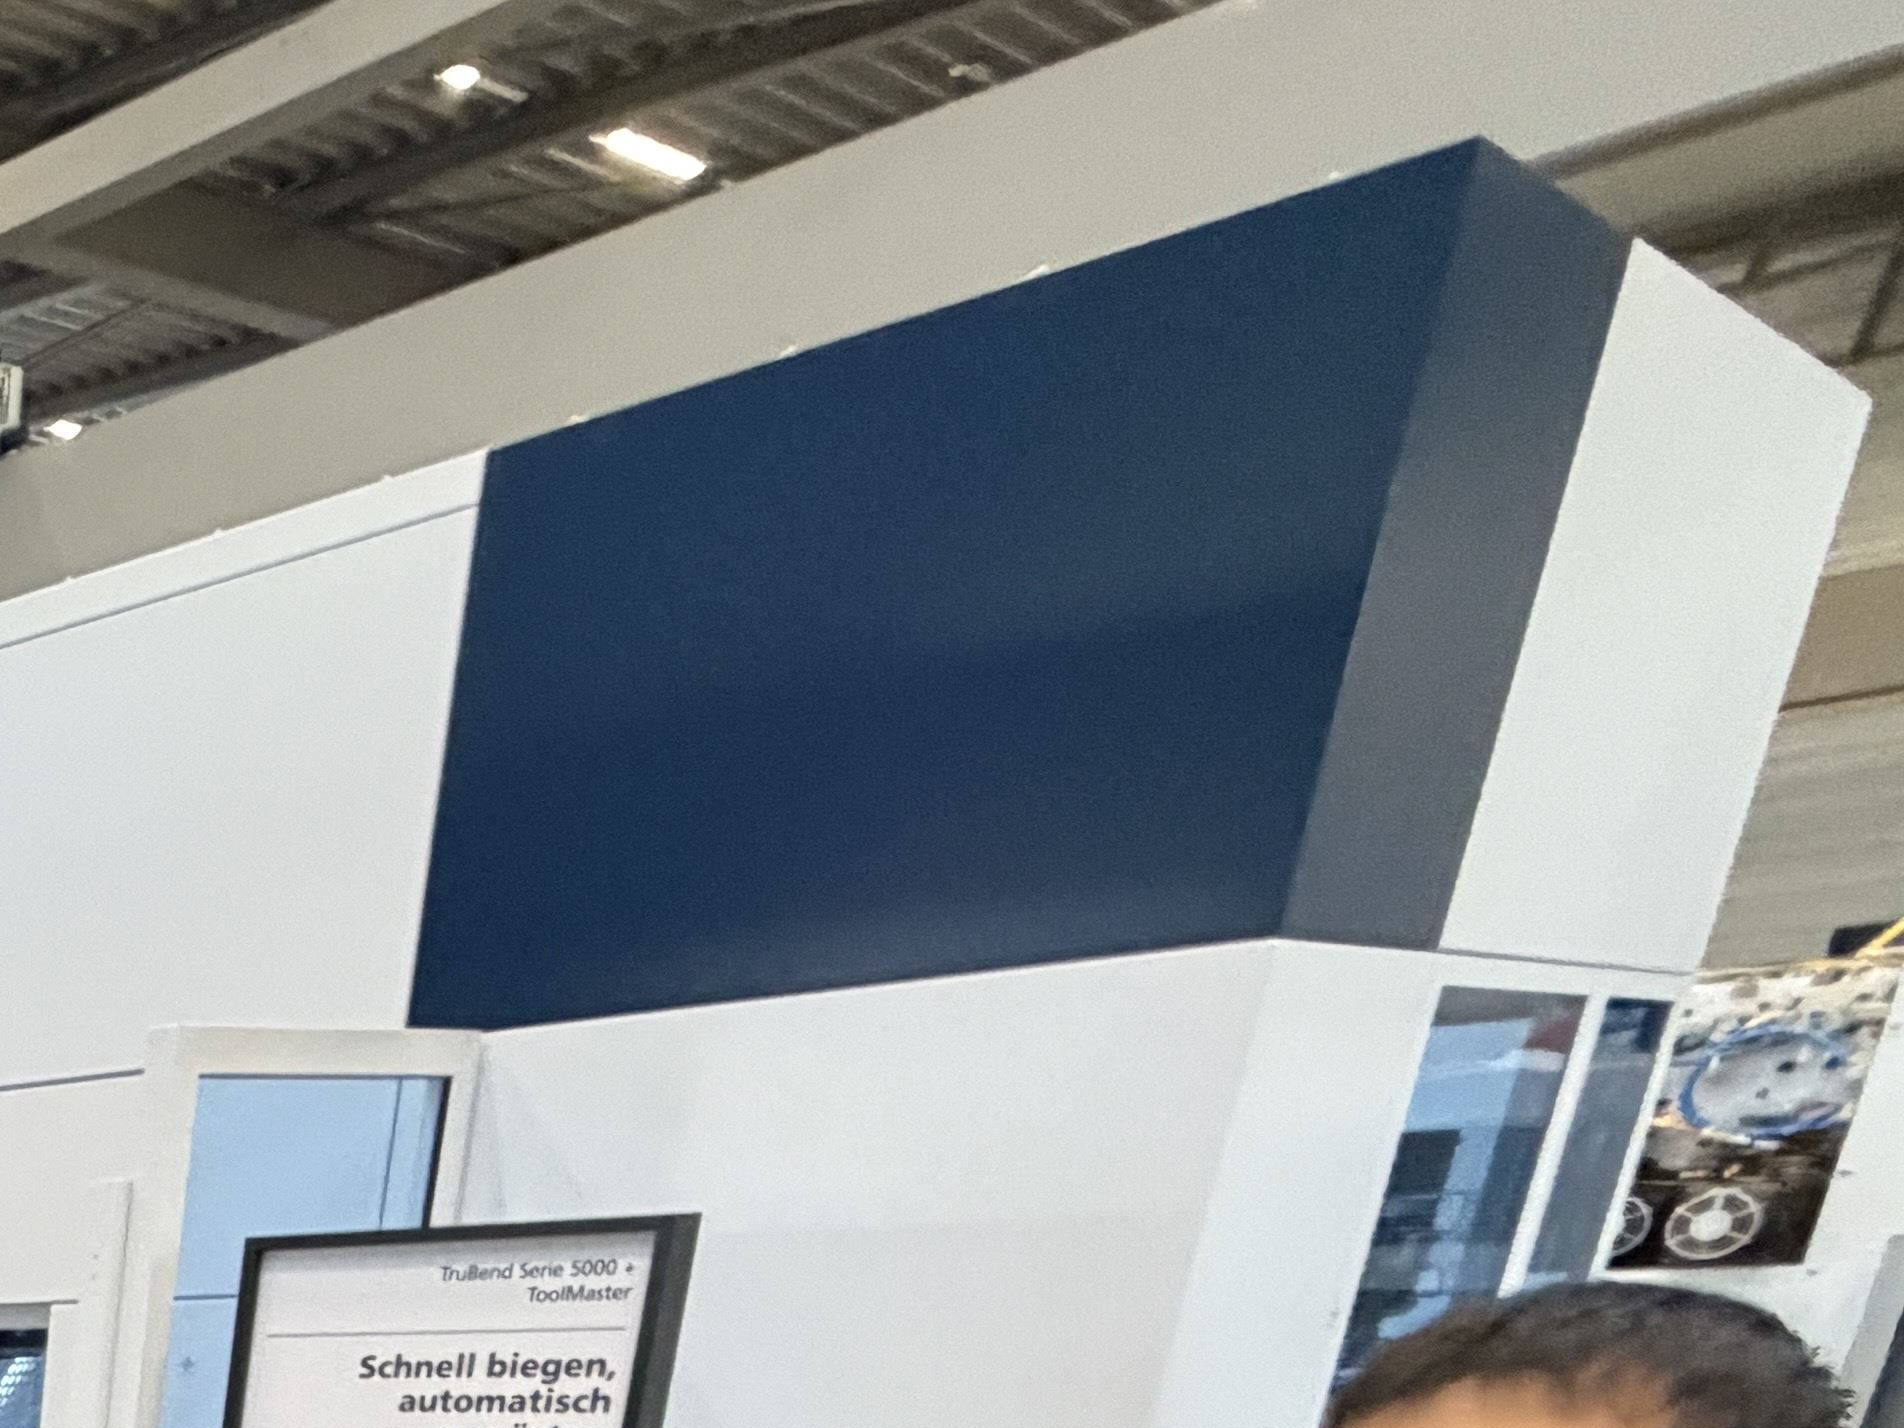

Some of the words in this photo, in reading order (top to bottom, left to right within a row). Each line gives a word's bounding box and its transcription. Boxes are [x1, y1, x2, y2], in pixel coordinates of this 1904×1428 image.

[441, 1263, 514, 1282] TruBend
[520, 1262, 564, 1279] Serie
[570, 1258, 618, 1277] 5000
[528, 1285, 634, 1303] ToolMaster
[358, 1351, 476, 1379] Schnell
[486, 1352, 616, 1385] biegen,
[398, 1386, 612, 1415] automatisch
